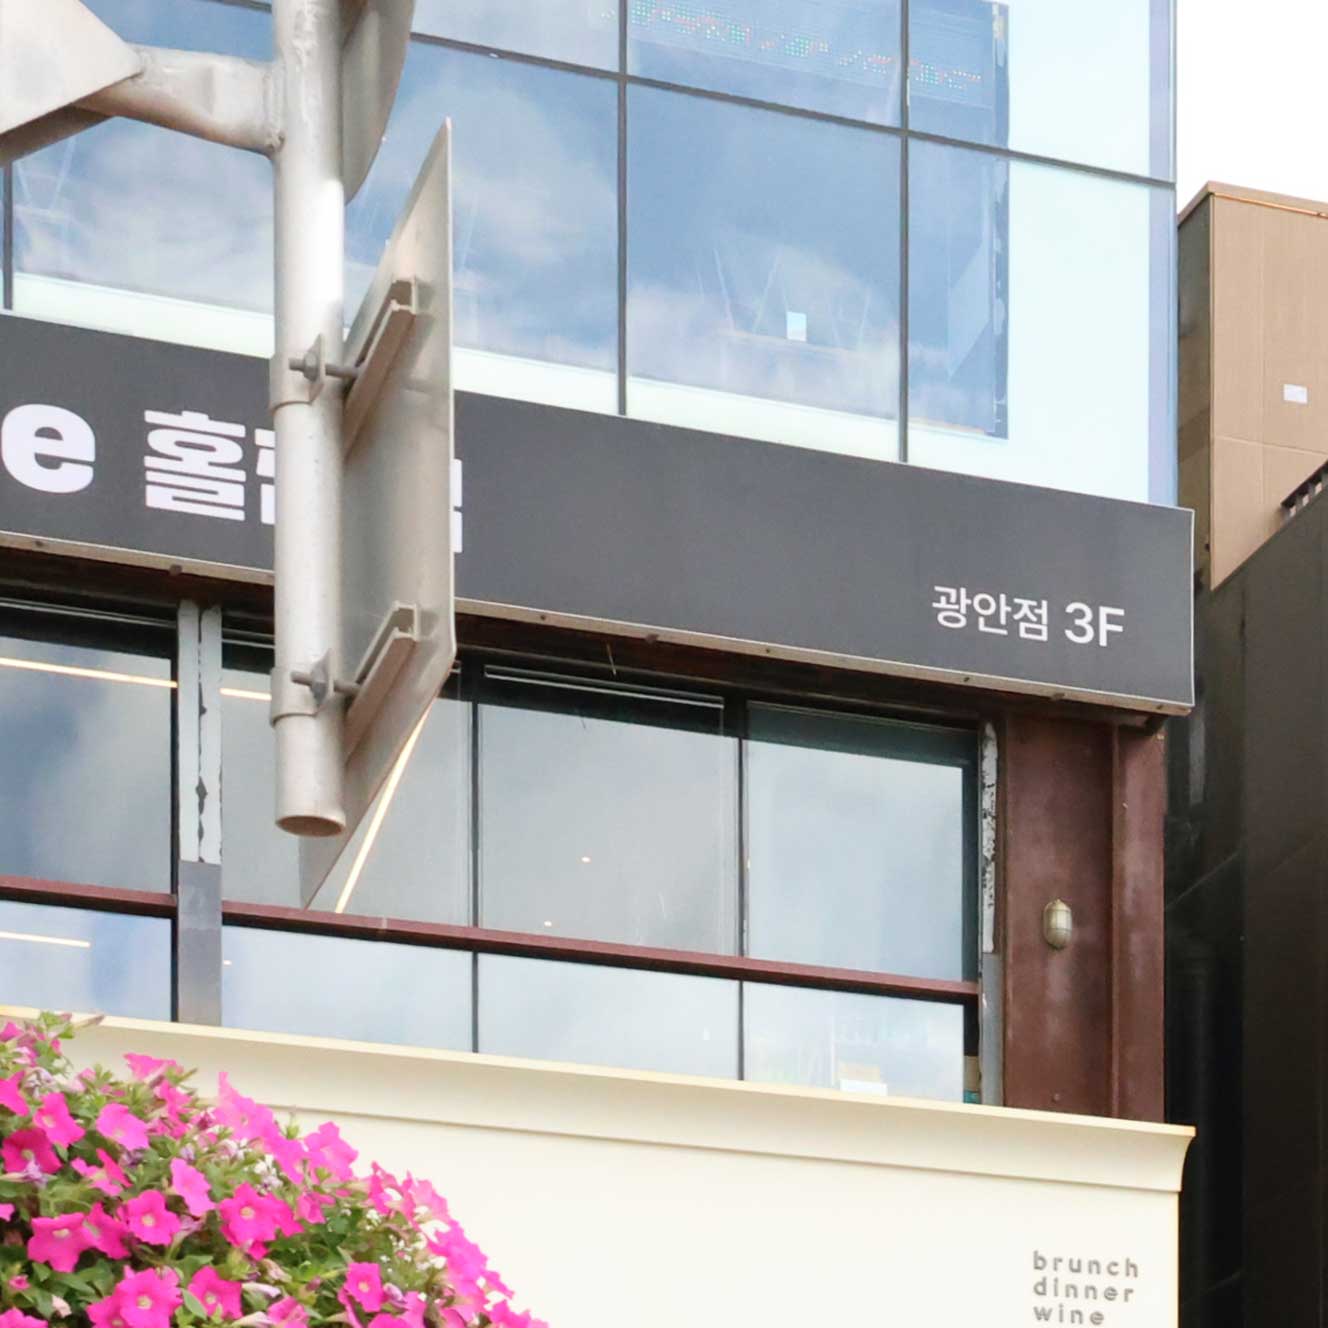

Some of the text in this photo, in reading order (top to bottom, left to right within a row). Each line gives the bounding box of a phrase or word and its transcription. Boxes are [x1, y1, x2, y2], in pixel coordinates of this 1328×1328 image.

[932, 585, 1125, 647] 광안점 3F
[1033, 1250, 1139, 1279] brunch
[1032, 1275, 1135, 1303] dinner
[1032, 1302, 1105, 1327] wine
